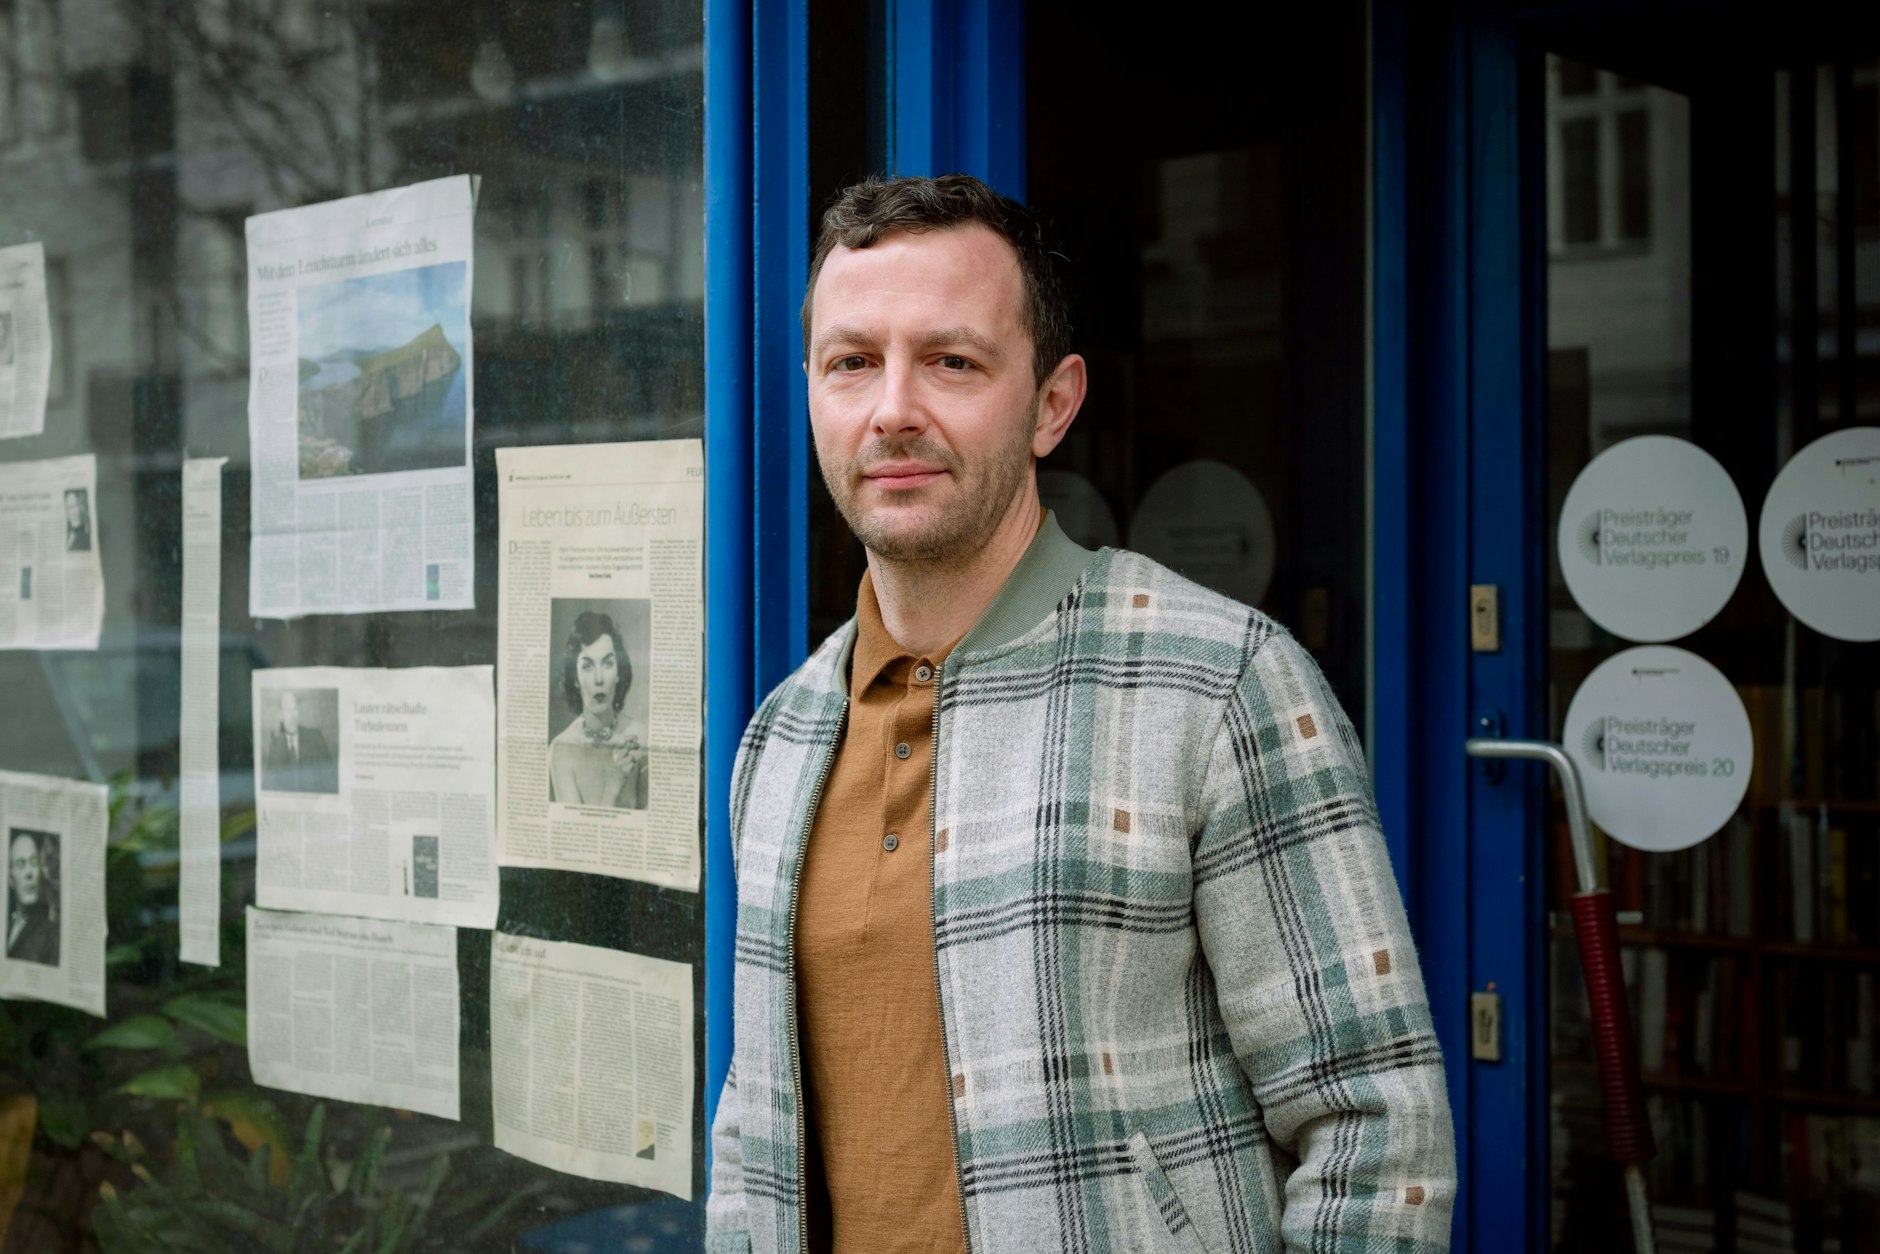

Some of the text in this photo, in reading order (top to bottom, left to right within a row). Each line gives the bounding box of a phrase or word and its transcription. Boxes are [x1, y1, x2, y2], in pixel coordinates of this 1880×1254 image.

[358, 246, 390, 265] ändert
[392, 239, 411, 258] sich
[414, 236, 438, 254] alles
[521, 502, 677, 528] Leben bis zum Äußersten
[1603, 507, 1694, 528] Preisträger
[1809, 507, 1880, 529] Preisträ
[1603, 528, 1688, 546] Deutscher
[1603, 545, 1730, 570] Verlagspreis 19
[1812, 552, 1880, 574] Verlags
[353, 700, 428, 715] Lauter rätselhafte
[1606, 715, 1696, 738] Preisträger
[1606, 736, 1690, 755] Deutscher
[1607, 756, 1735, 779] Verlagspreis 20
